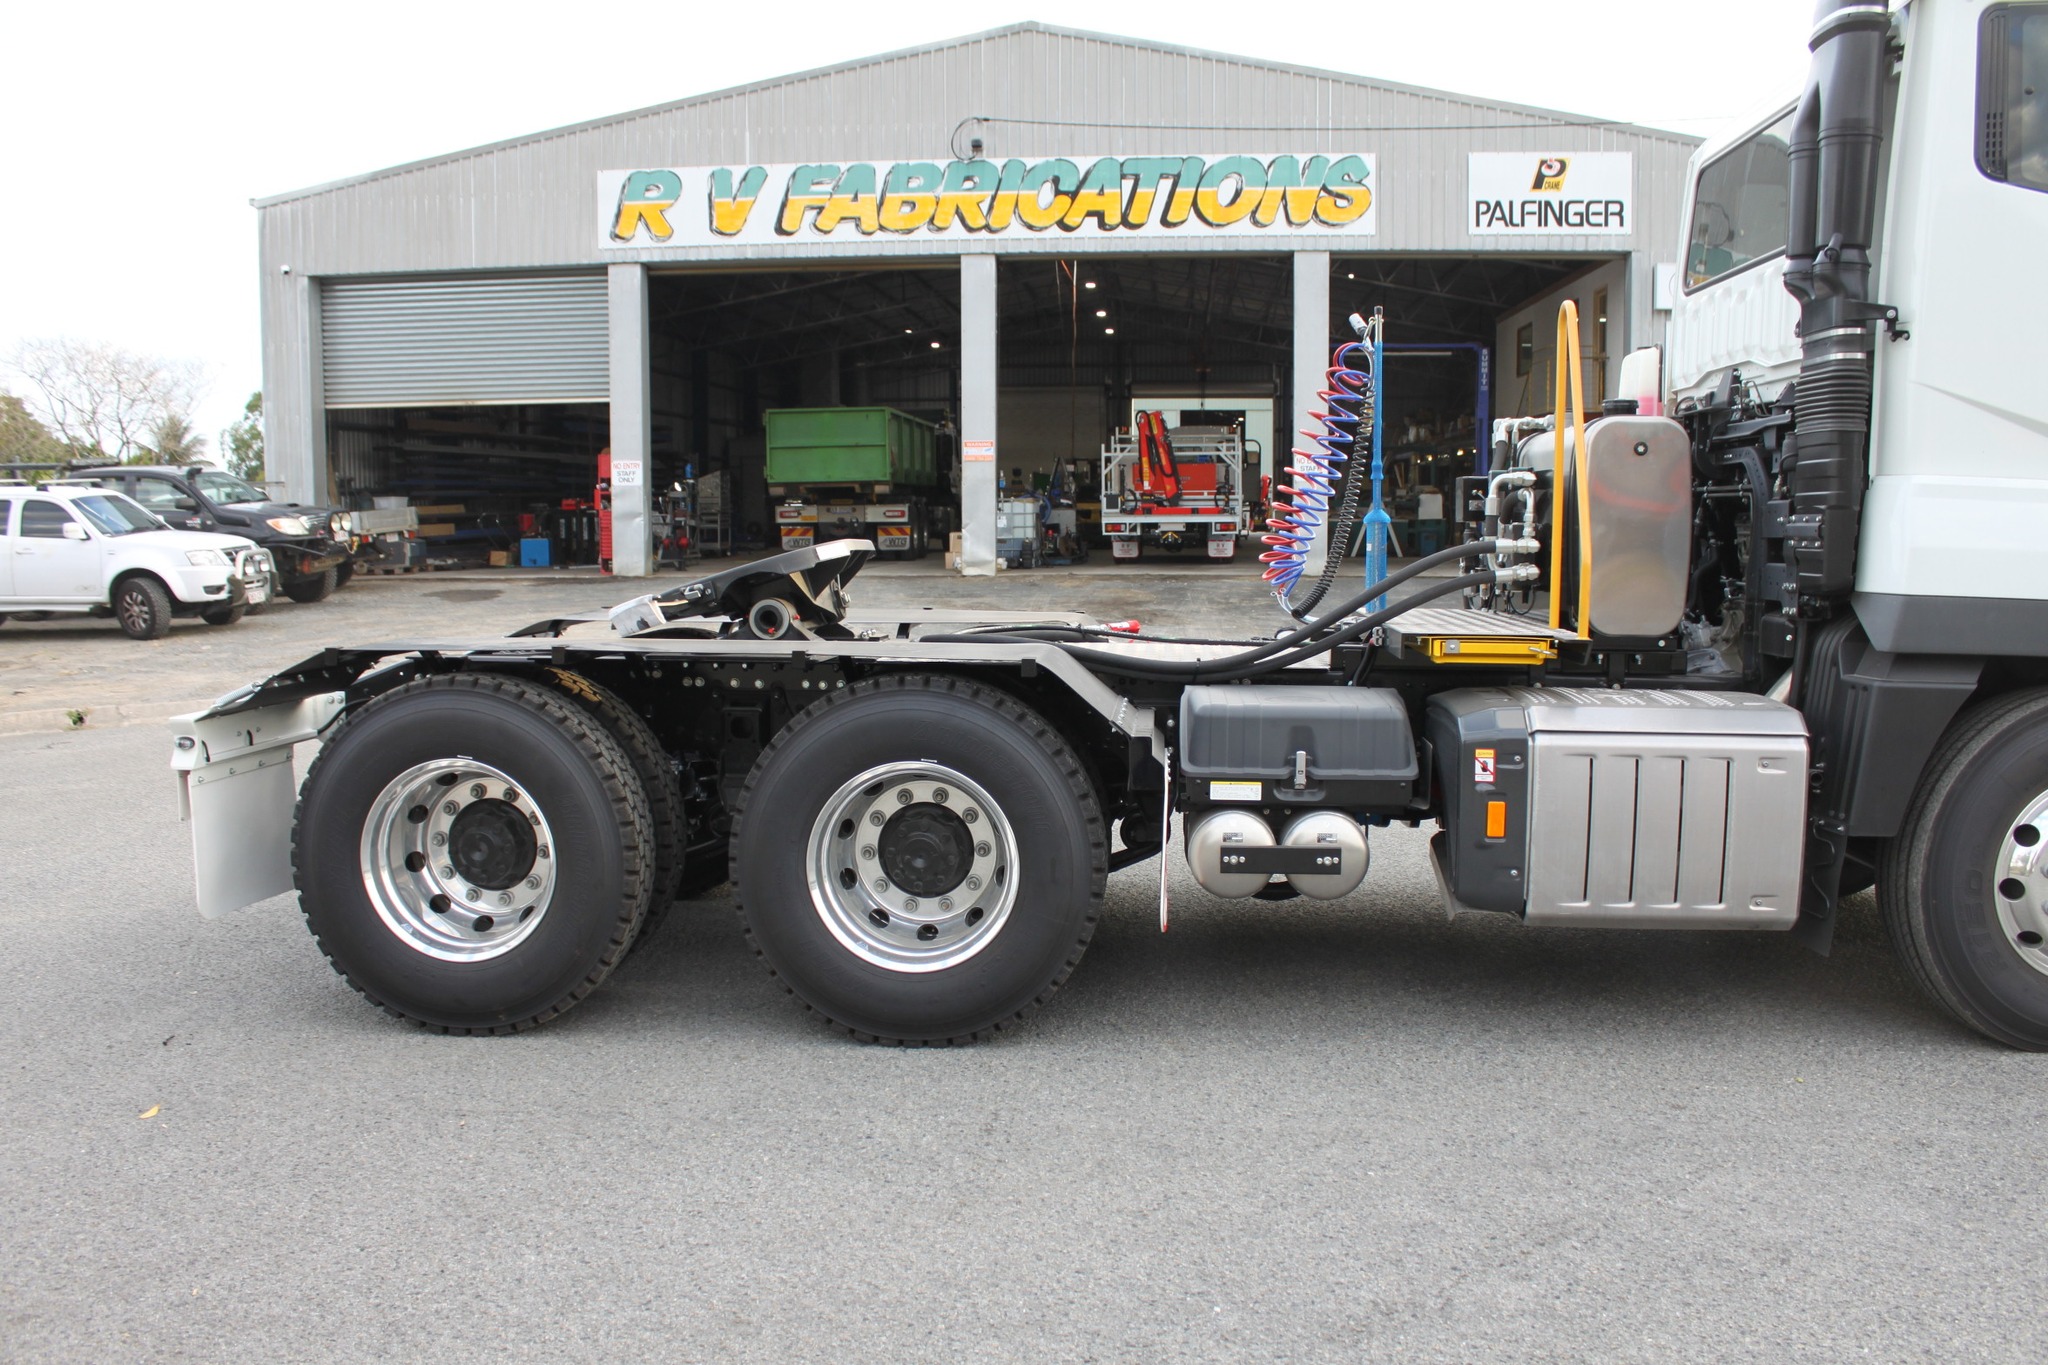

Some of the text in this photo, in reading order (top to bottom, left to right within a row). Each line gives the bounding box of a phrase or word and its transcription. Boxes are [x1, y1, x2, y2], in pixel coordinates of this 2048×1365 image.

[610, 154, 1372, 243] R V FABRICATIONS
[1475, 200, 1625, 227] PALFINGER
[613, 462, 640, 470] NO ENTRY
